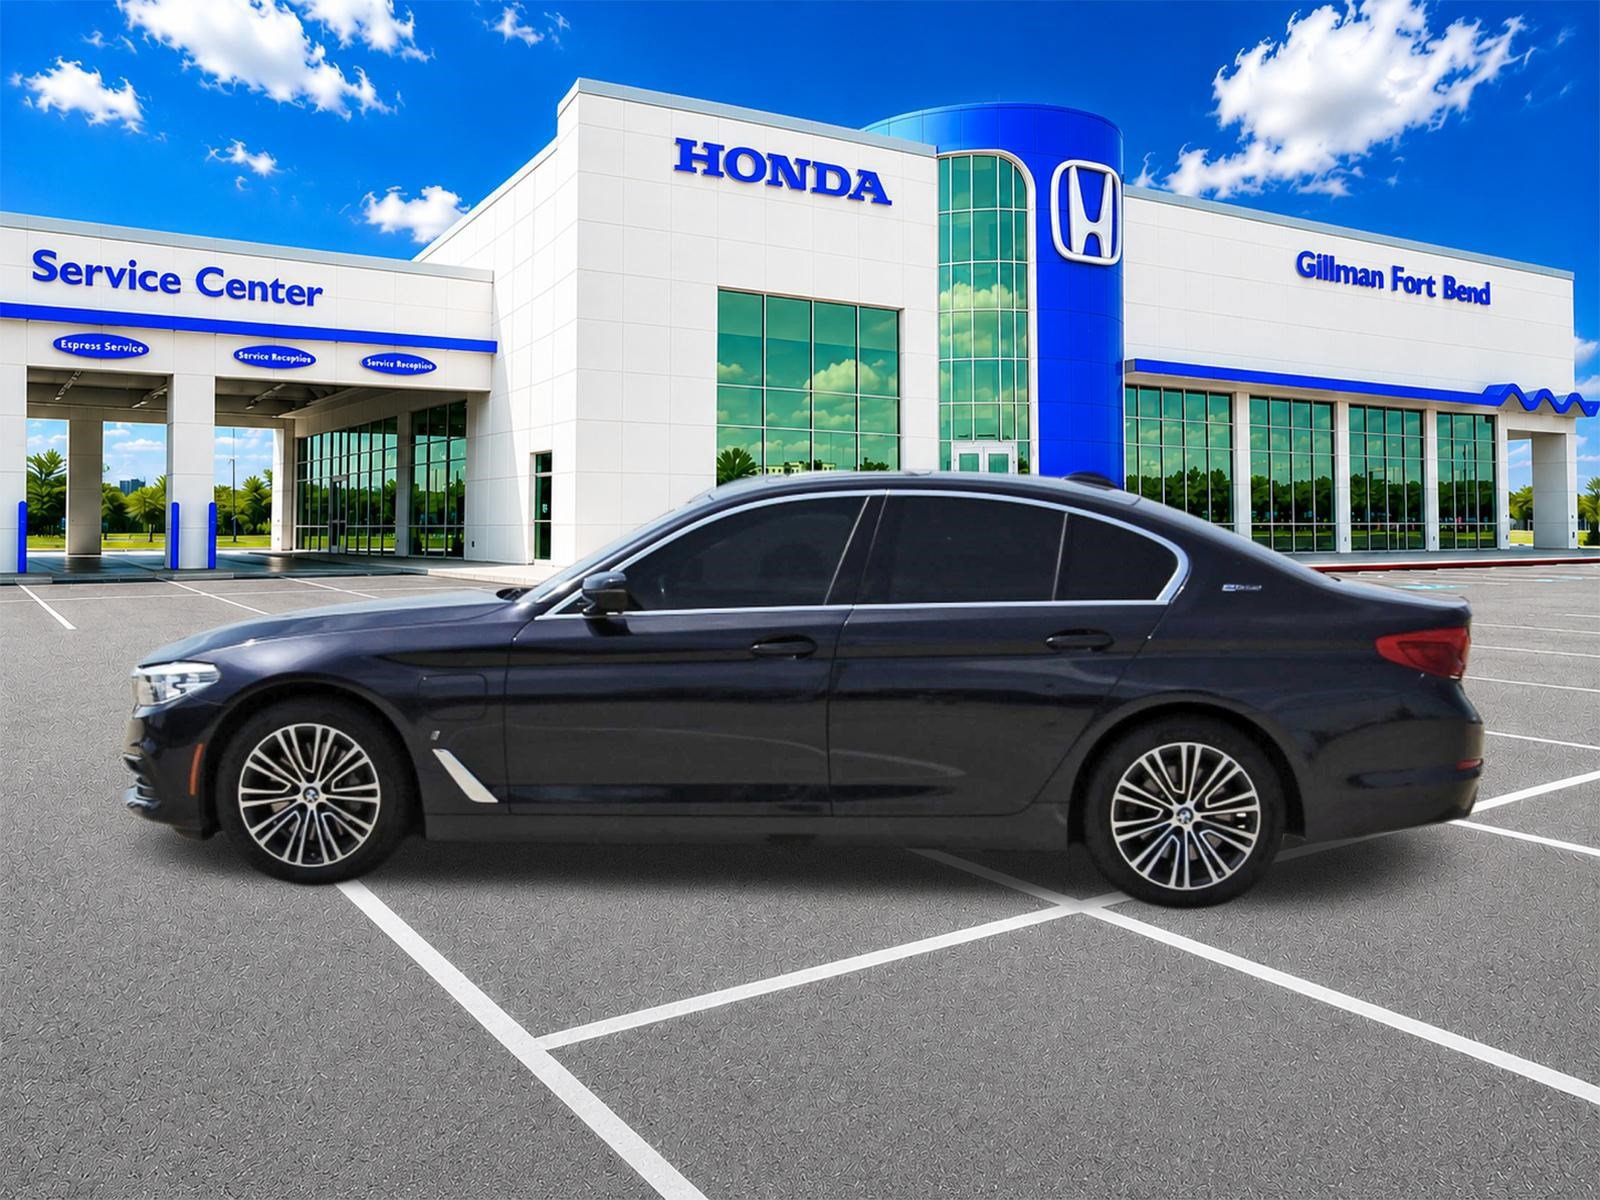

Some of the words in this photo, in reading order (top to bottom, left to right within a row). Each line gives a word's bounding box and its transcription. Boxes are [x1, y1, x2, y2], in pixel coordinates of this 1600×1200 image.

[674, 137, 893, 206] HONDA
[32, 250, 181, 295] Service
[195, 266, 323, 307] Center
[1296, 250, 1385, 289] Gillman
[1391, 265, 1437, 298] Fort
[1442, 275, 1491, 305] Bend
[60, 339, 101, 352] Express
[104, 342, 144, 353] Service
[238, 351, 269, 361] Service
[366, 358, 395, 368] Service
